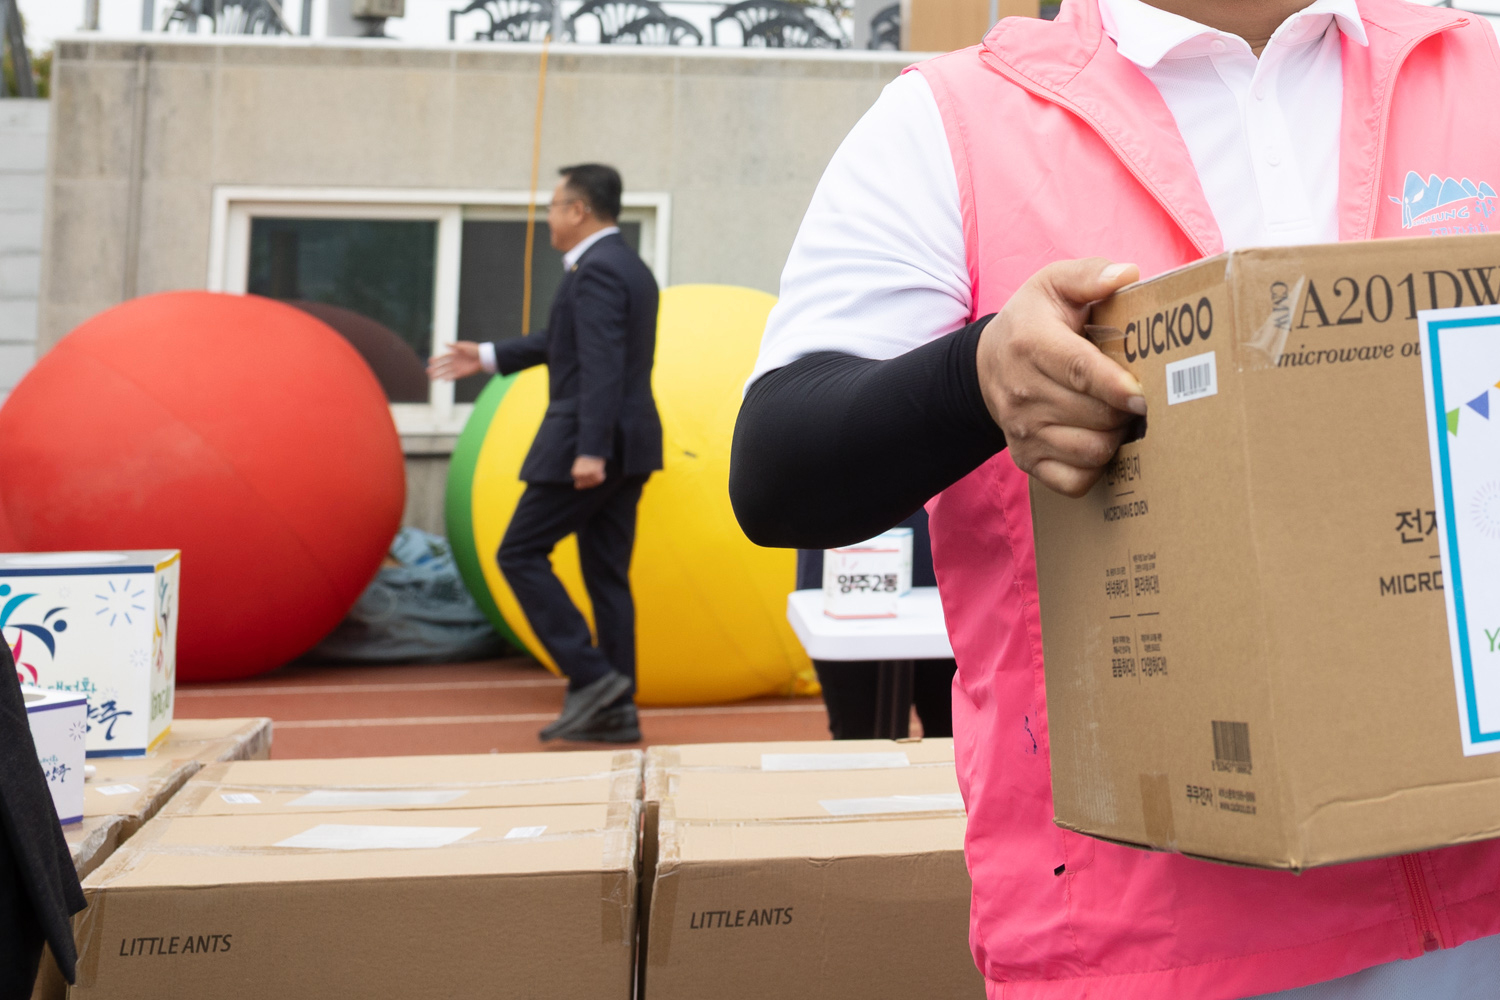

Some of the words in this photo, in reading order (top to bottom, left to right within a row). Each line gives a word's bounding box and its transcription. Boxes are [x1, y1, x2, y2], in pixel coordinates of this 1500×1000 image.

[1124, 297, 1213, 363] CUCKOO
[1277, 343, 1394, 369] microwave
[838, 573, 898, 594] 양주2동
[690, 910, 746, 930] LITTLE
[747, 907, 794, 927] ANTS
[119, 936, 180, 957] LITTLE
[181, 934, 233, 954] ANTS
